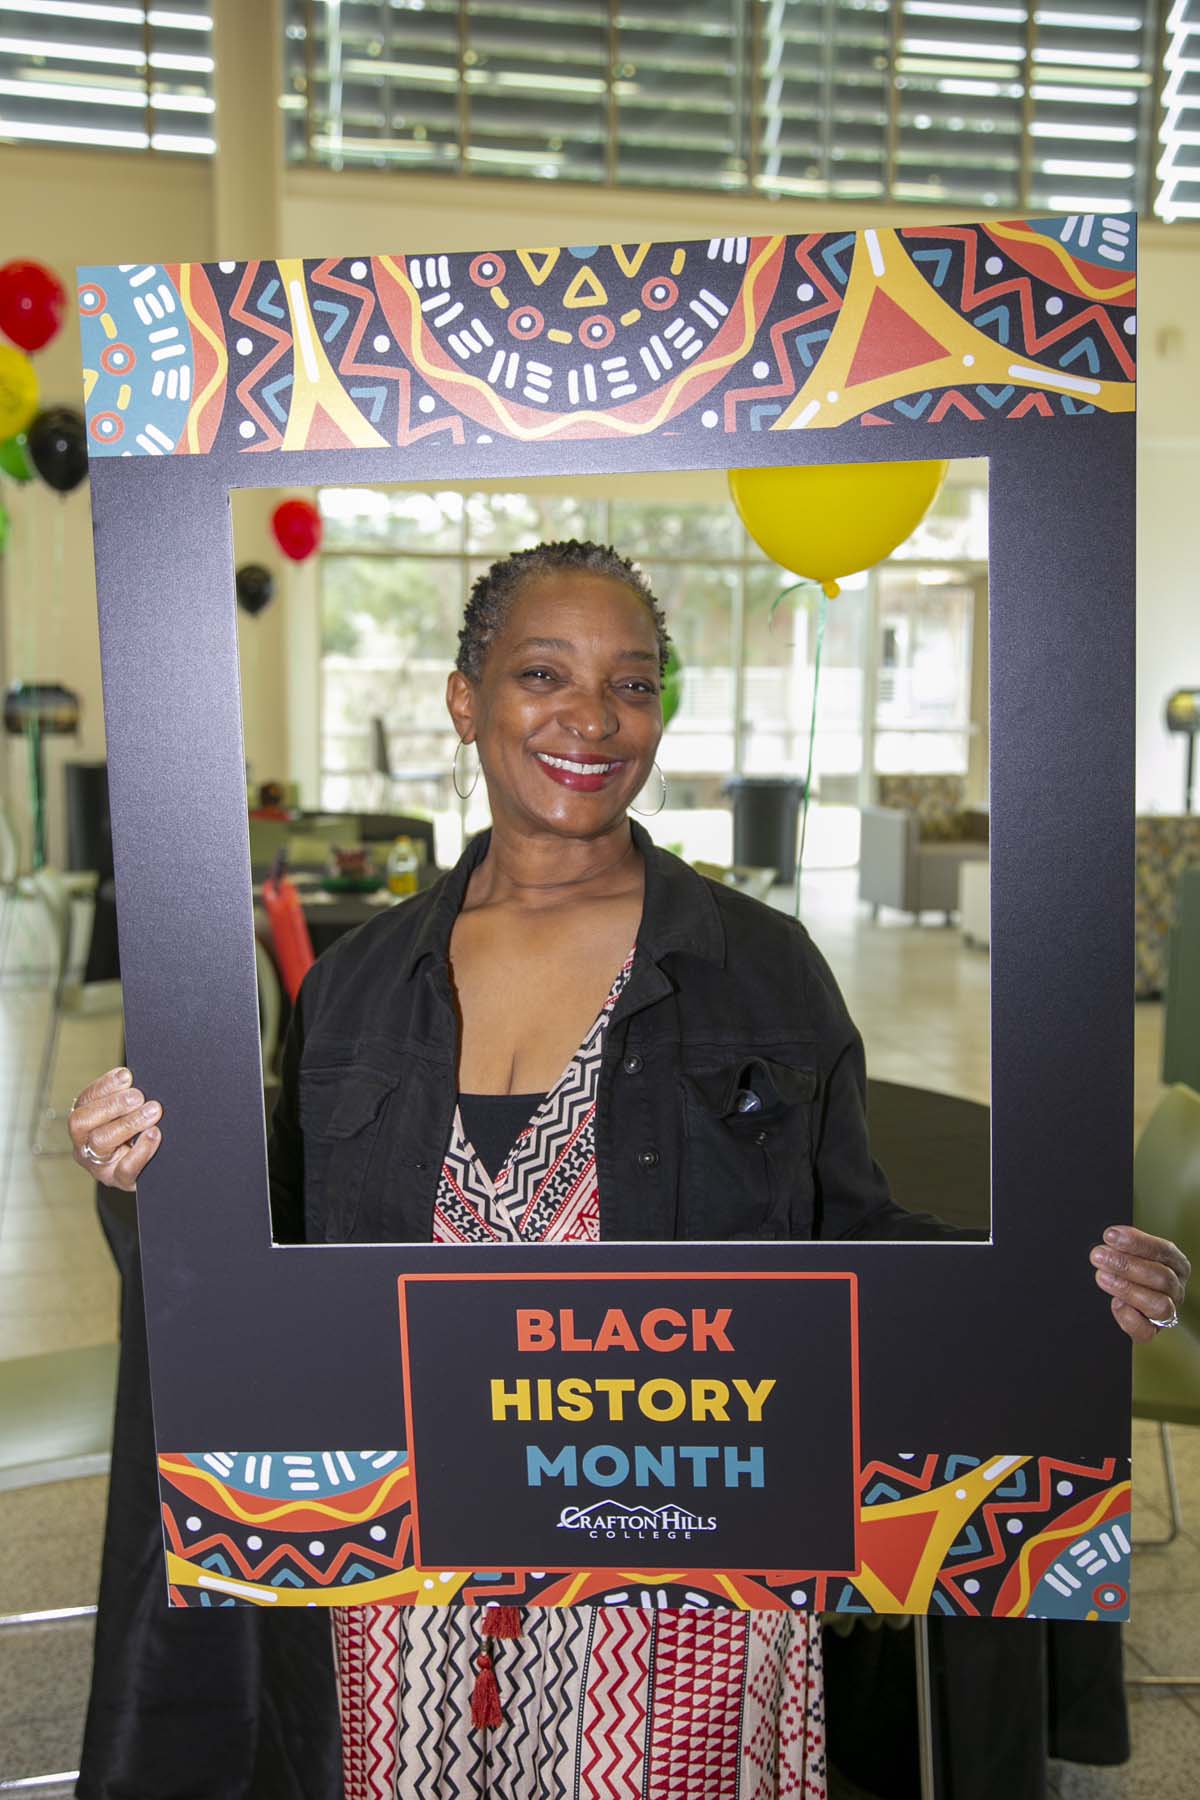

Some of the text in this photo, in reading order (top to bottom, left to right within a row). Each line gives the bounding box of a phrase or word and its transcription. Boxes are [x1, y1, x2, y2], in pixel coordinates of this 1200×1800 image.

[516, 1308, 735, 1352] BLACK
[490, 1378, 777, 1422] HISTORY
[526, 1445, 765, 1488] MONTH
[556, 1506, 717, 1531] CRAFTON HILLS
[589, 1530, 692, 1540] COLLEGE
